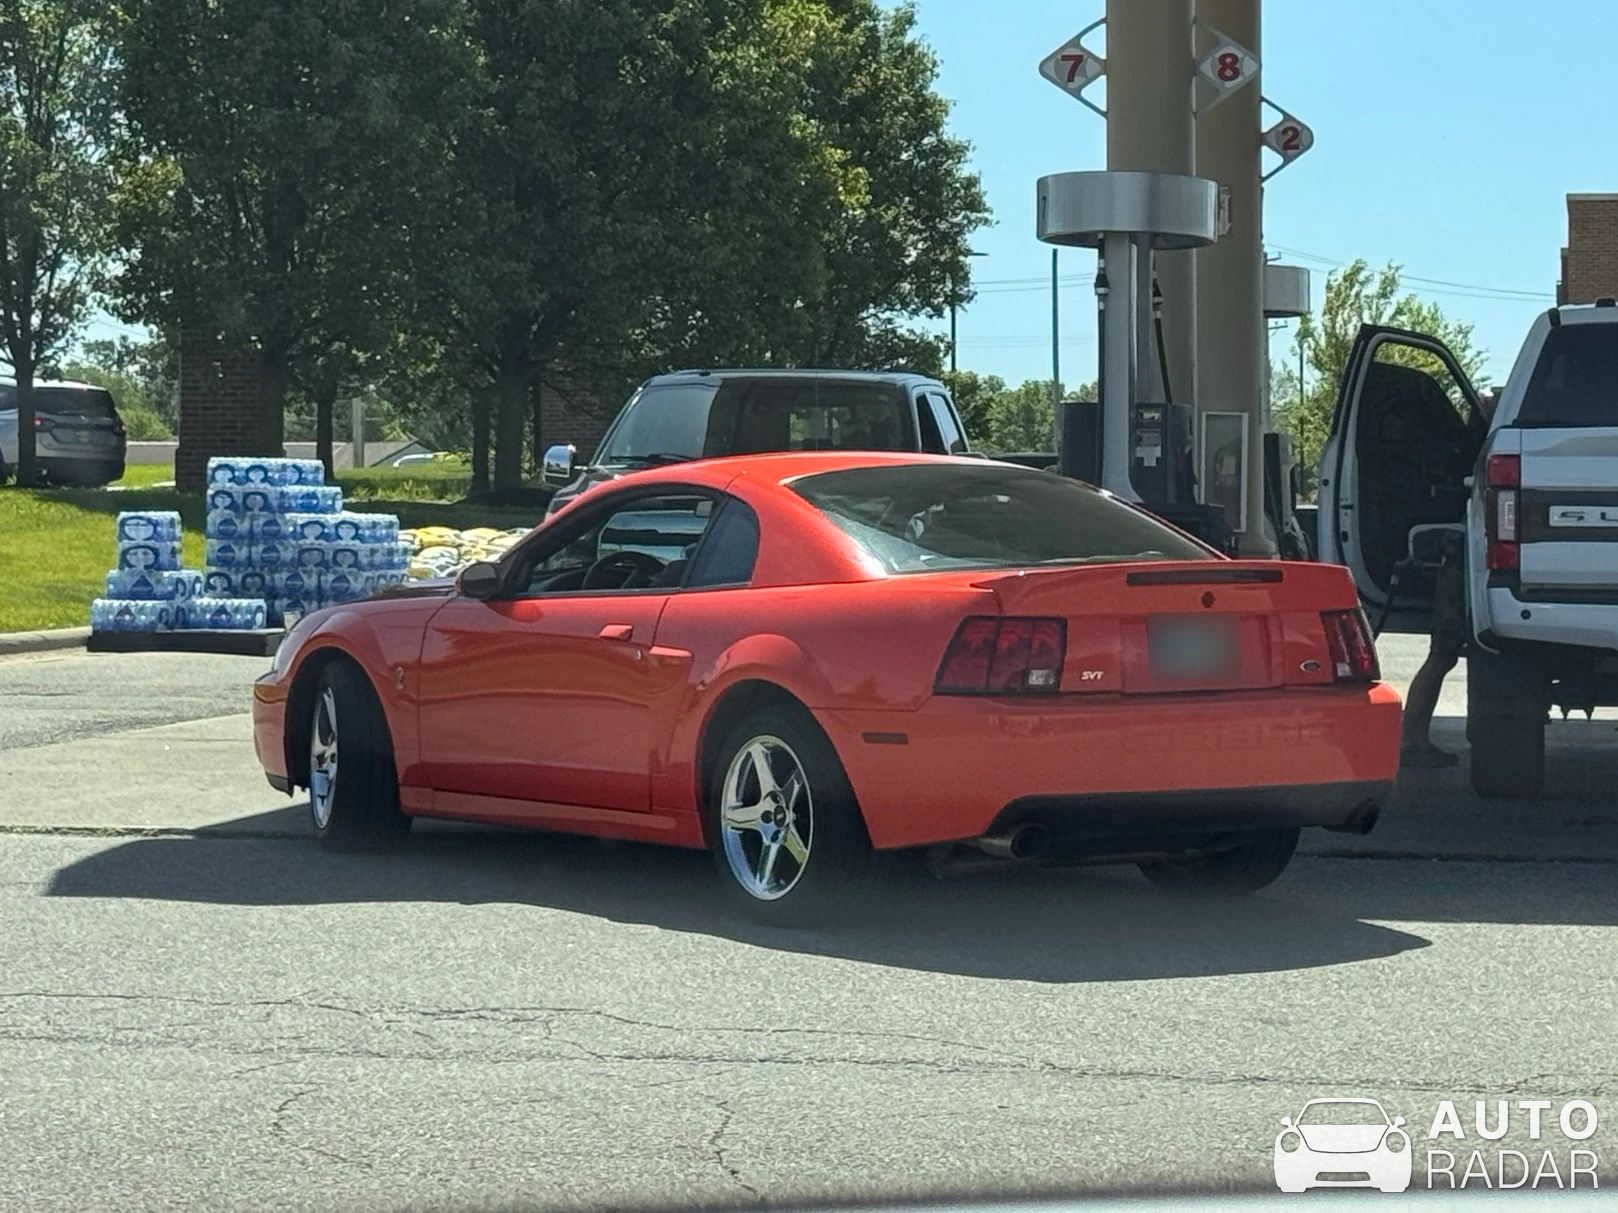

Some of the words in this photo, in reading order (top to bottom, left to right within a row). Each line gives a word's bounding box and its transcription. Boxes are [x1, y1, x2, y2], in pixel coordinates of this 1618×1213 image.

[1061, 54, 1084, 82] 7
[1217, 53, 1240, 81] 8
[1280, 126, 1300, 150] 2
[1081, 671, 1104, 680] SVT
